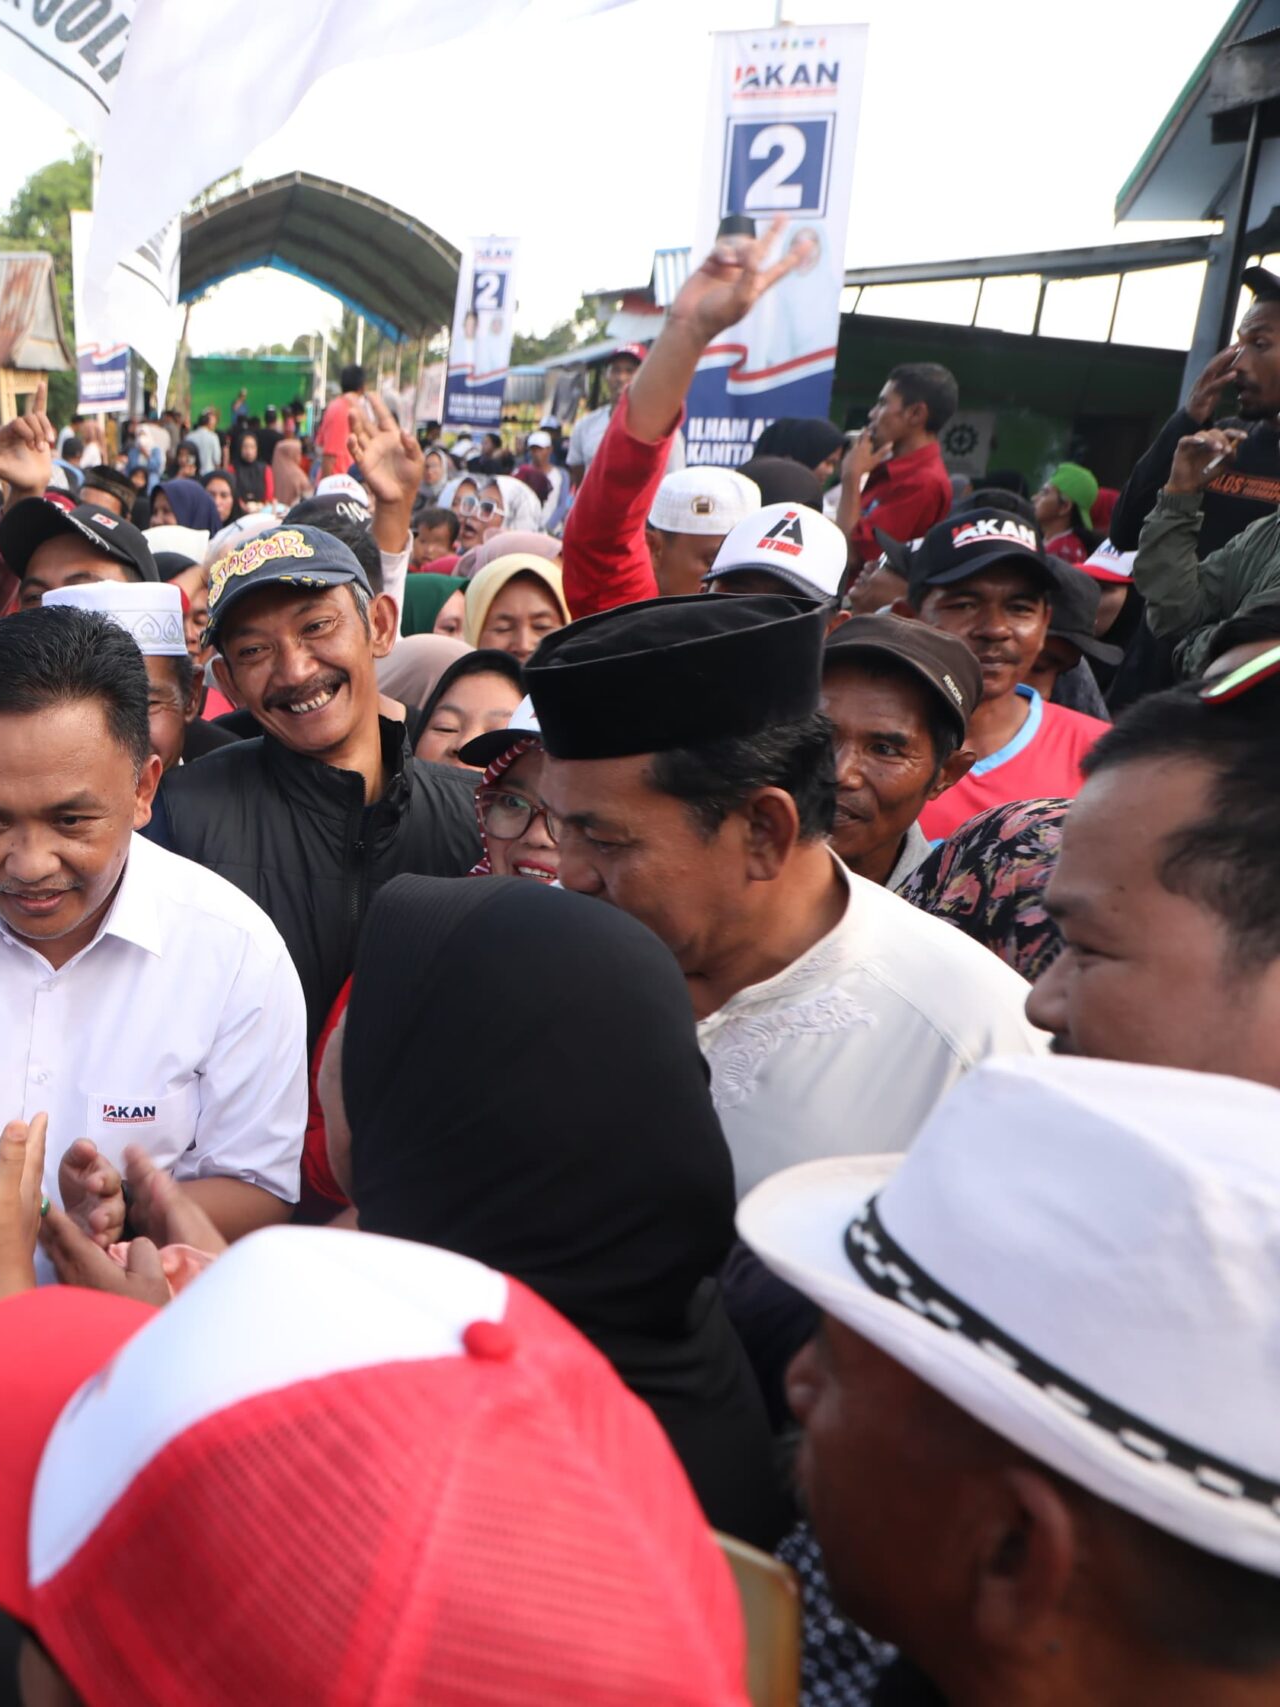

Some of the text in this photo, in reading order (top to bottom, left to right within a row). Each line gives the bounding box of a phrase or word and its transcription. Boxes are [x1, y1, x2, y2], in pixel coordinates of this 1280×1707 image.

[744, 124, 806, 210] 2
[476, 273, 500, 309] 2
[687, 417, 750, 441] ILHAM
